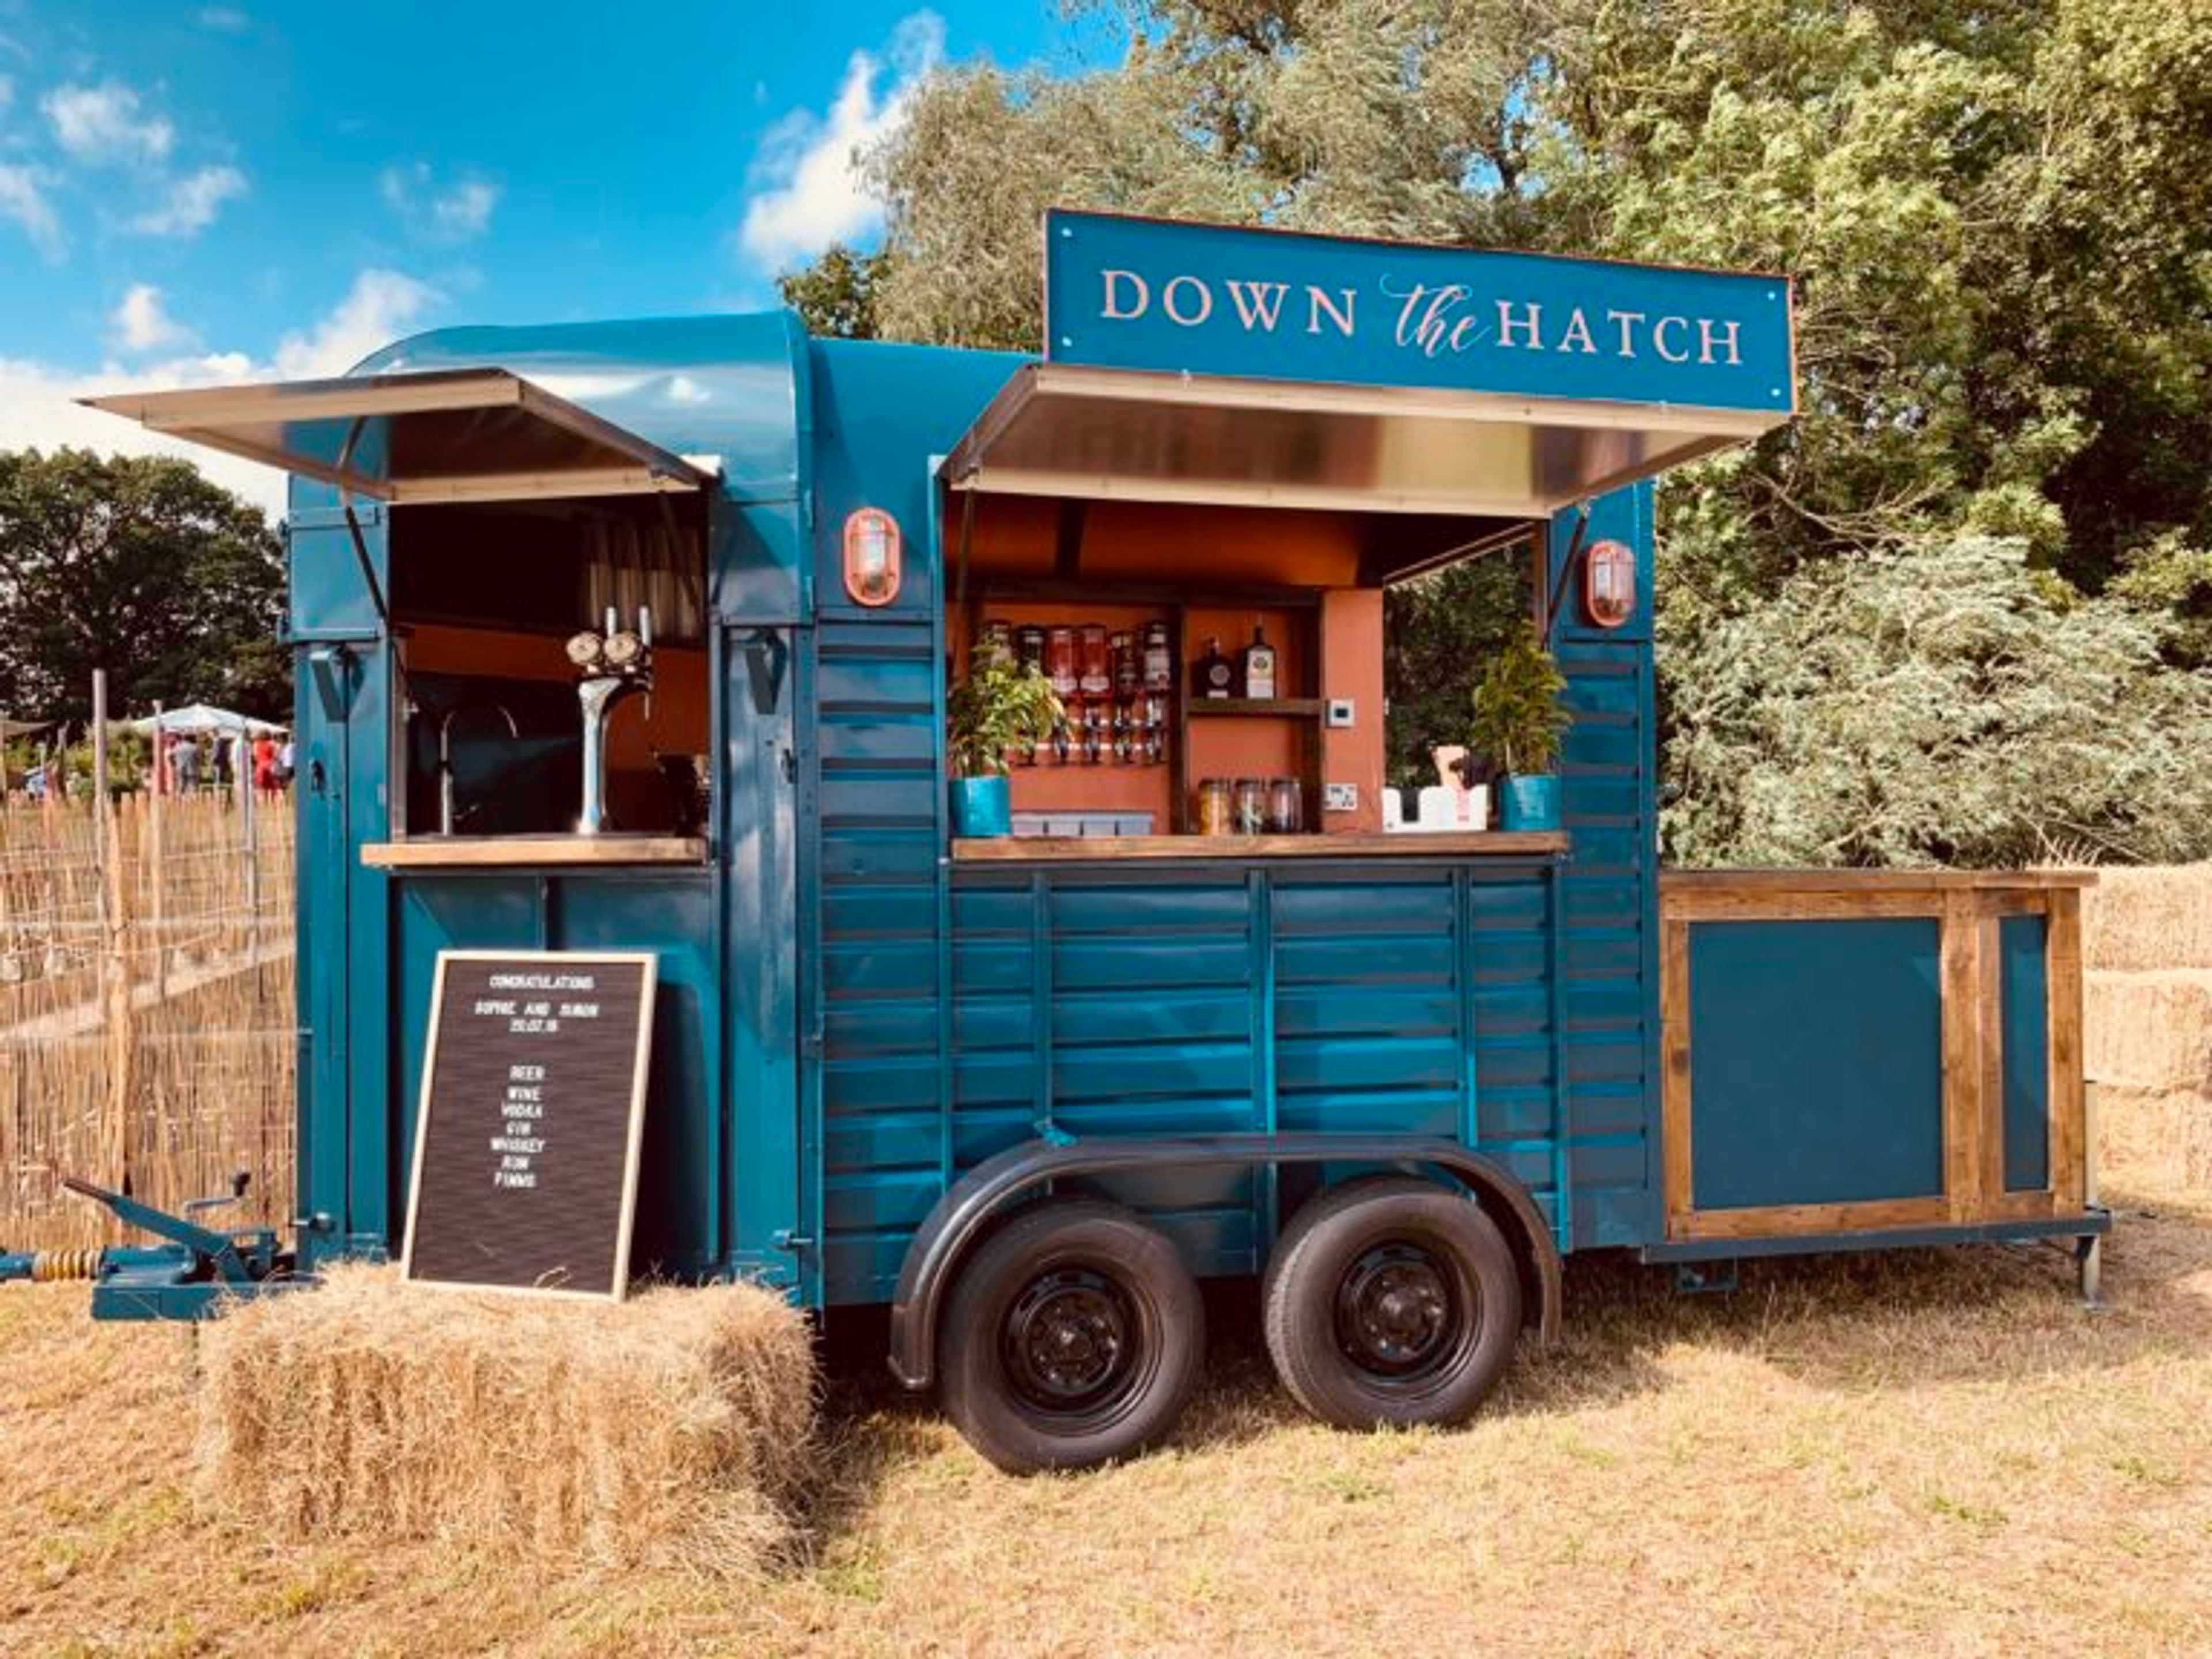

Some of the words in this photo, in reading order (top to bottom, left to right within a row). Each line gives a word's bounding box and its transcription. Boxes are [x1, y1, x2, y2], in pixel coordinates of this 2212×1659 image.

[1100, 270, 1357, 336] DOWN
[1379, 273, 1491, 358] the
[1495, 299, 1743, 365] HATCH
[523, 1001, 551, 1017] AND
[509, 1065, 546, 1081] BEER
[507, 1086, 543, 1102] WINE
[500, 1101, 543, 1119] VODKA
[505, 1120, 532, 1136] GIN
[489, 1137, 546, 1154] WHISKEY
[501, 1154, 530, 1171] RUM
